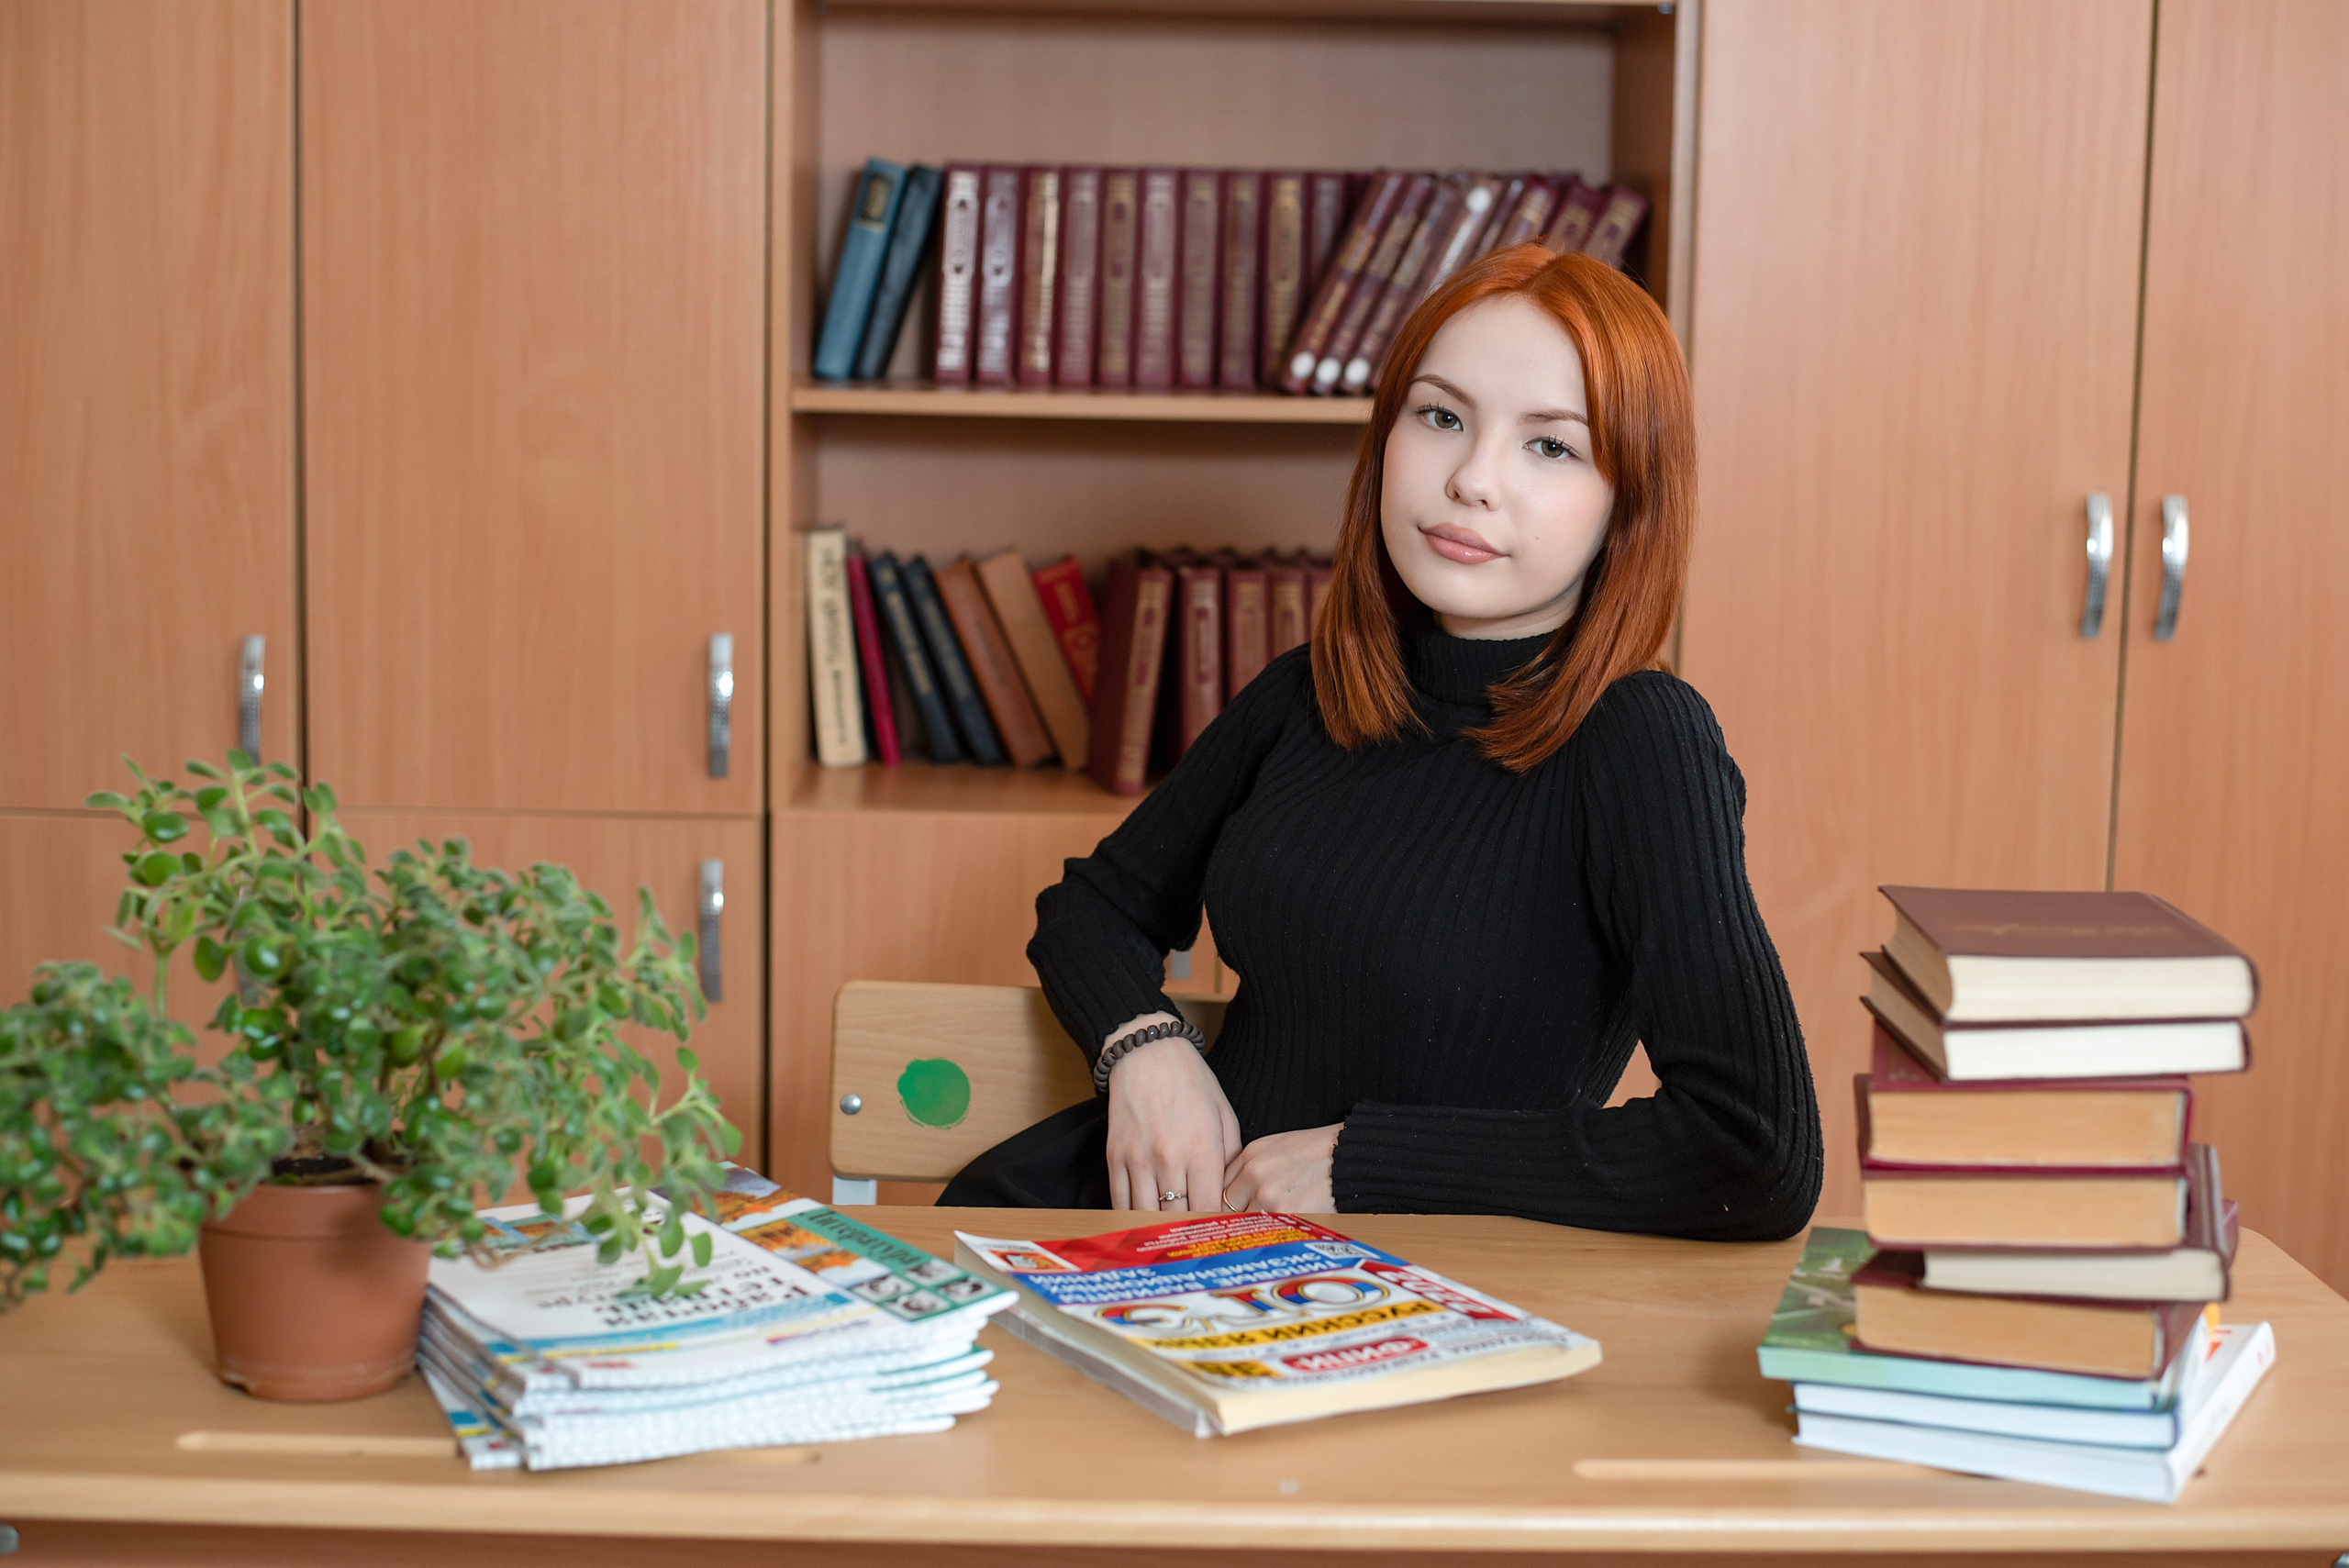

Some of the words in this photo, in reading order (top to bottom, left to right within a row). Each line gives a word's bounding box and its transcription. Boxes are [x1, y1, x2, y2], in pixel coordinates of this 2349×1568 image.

[1212, 1260, 1342, 1287] ТИПОВЫЕ
[1058, 1280, 1207, 1304] ВАРИАНТЫ
[1095, 1275, 1392, 1332] ОГЭ
[1376, 1270, 1494, 1314] 2022
